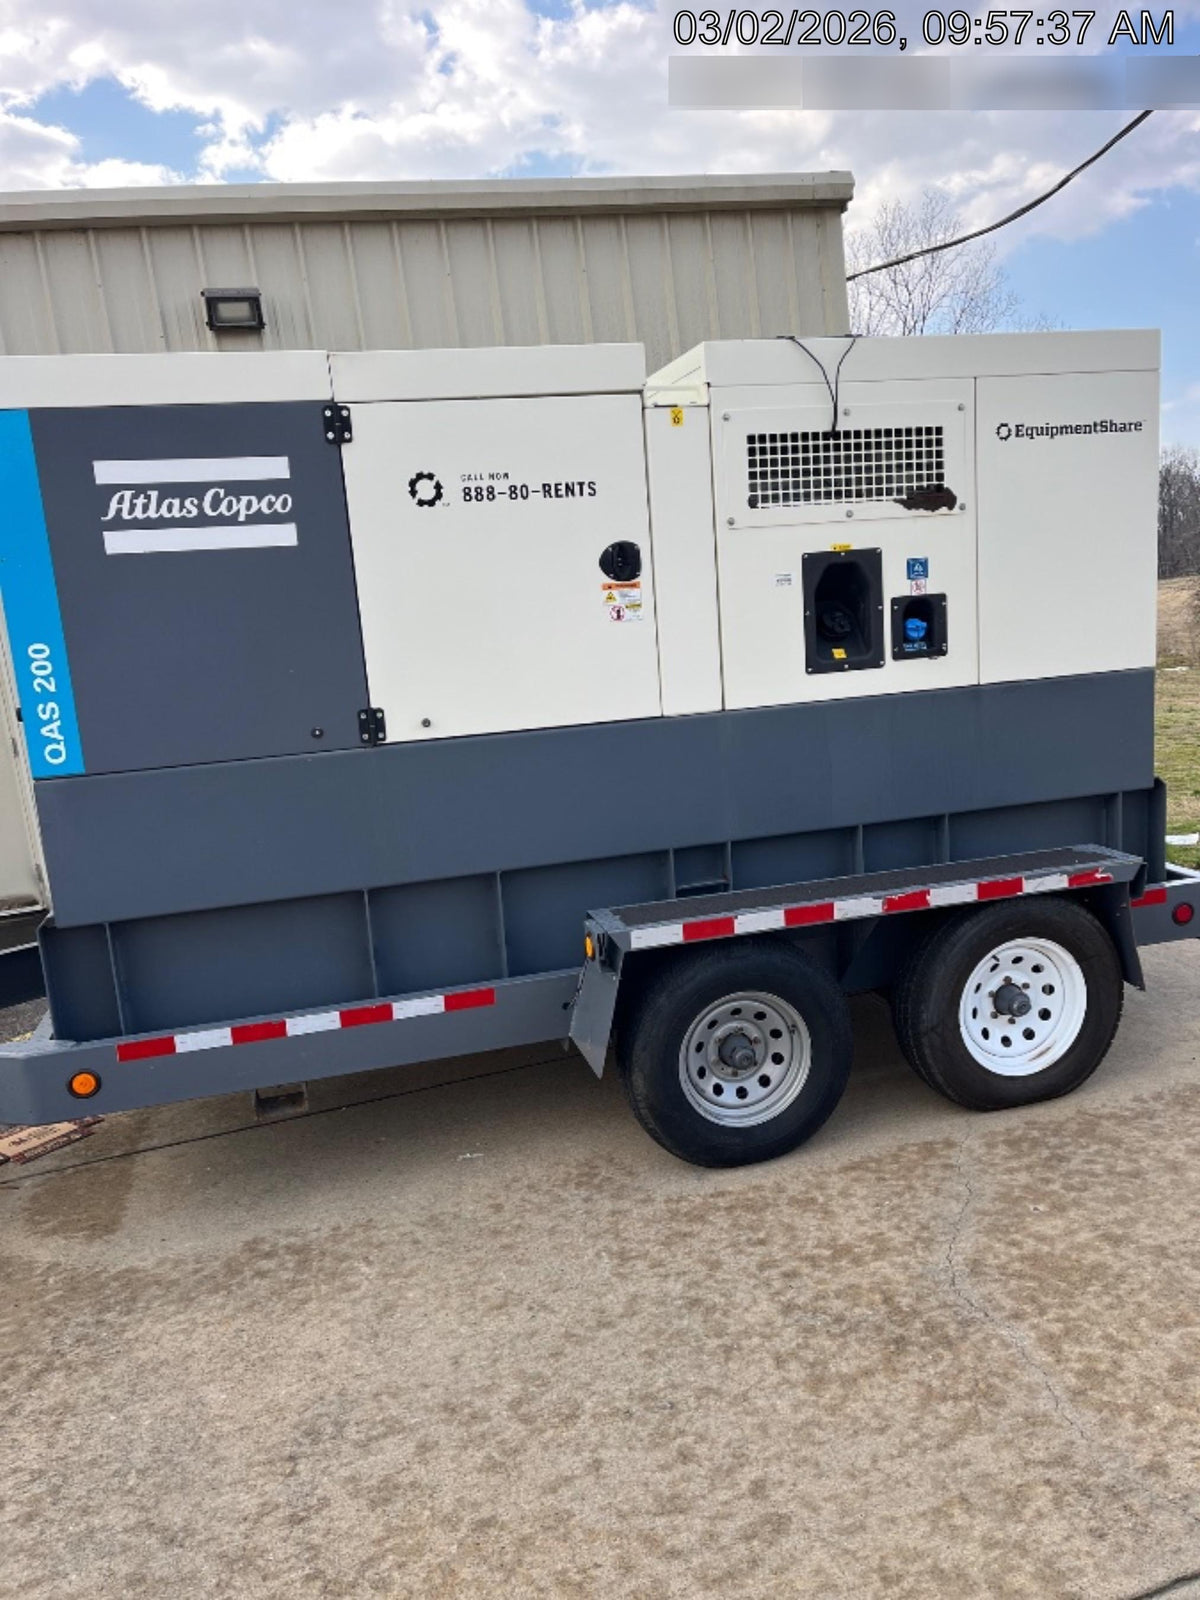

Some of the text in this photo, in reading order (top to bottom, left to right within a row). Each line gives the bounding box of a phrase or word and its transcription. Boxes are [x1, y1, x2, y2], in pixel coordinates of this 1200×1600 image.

[1014, 419, 1143, 440] EquipmentShare
[460, 472, 509, 482] CALL NOW
[462, 481, 598, 502] 888-80-RENTS
[101, 487, 293, 522] Atlas Copco
[27, 642, 67, 765] QAS 200
